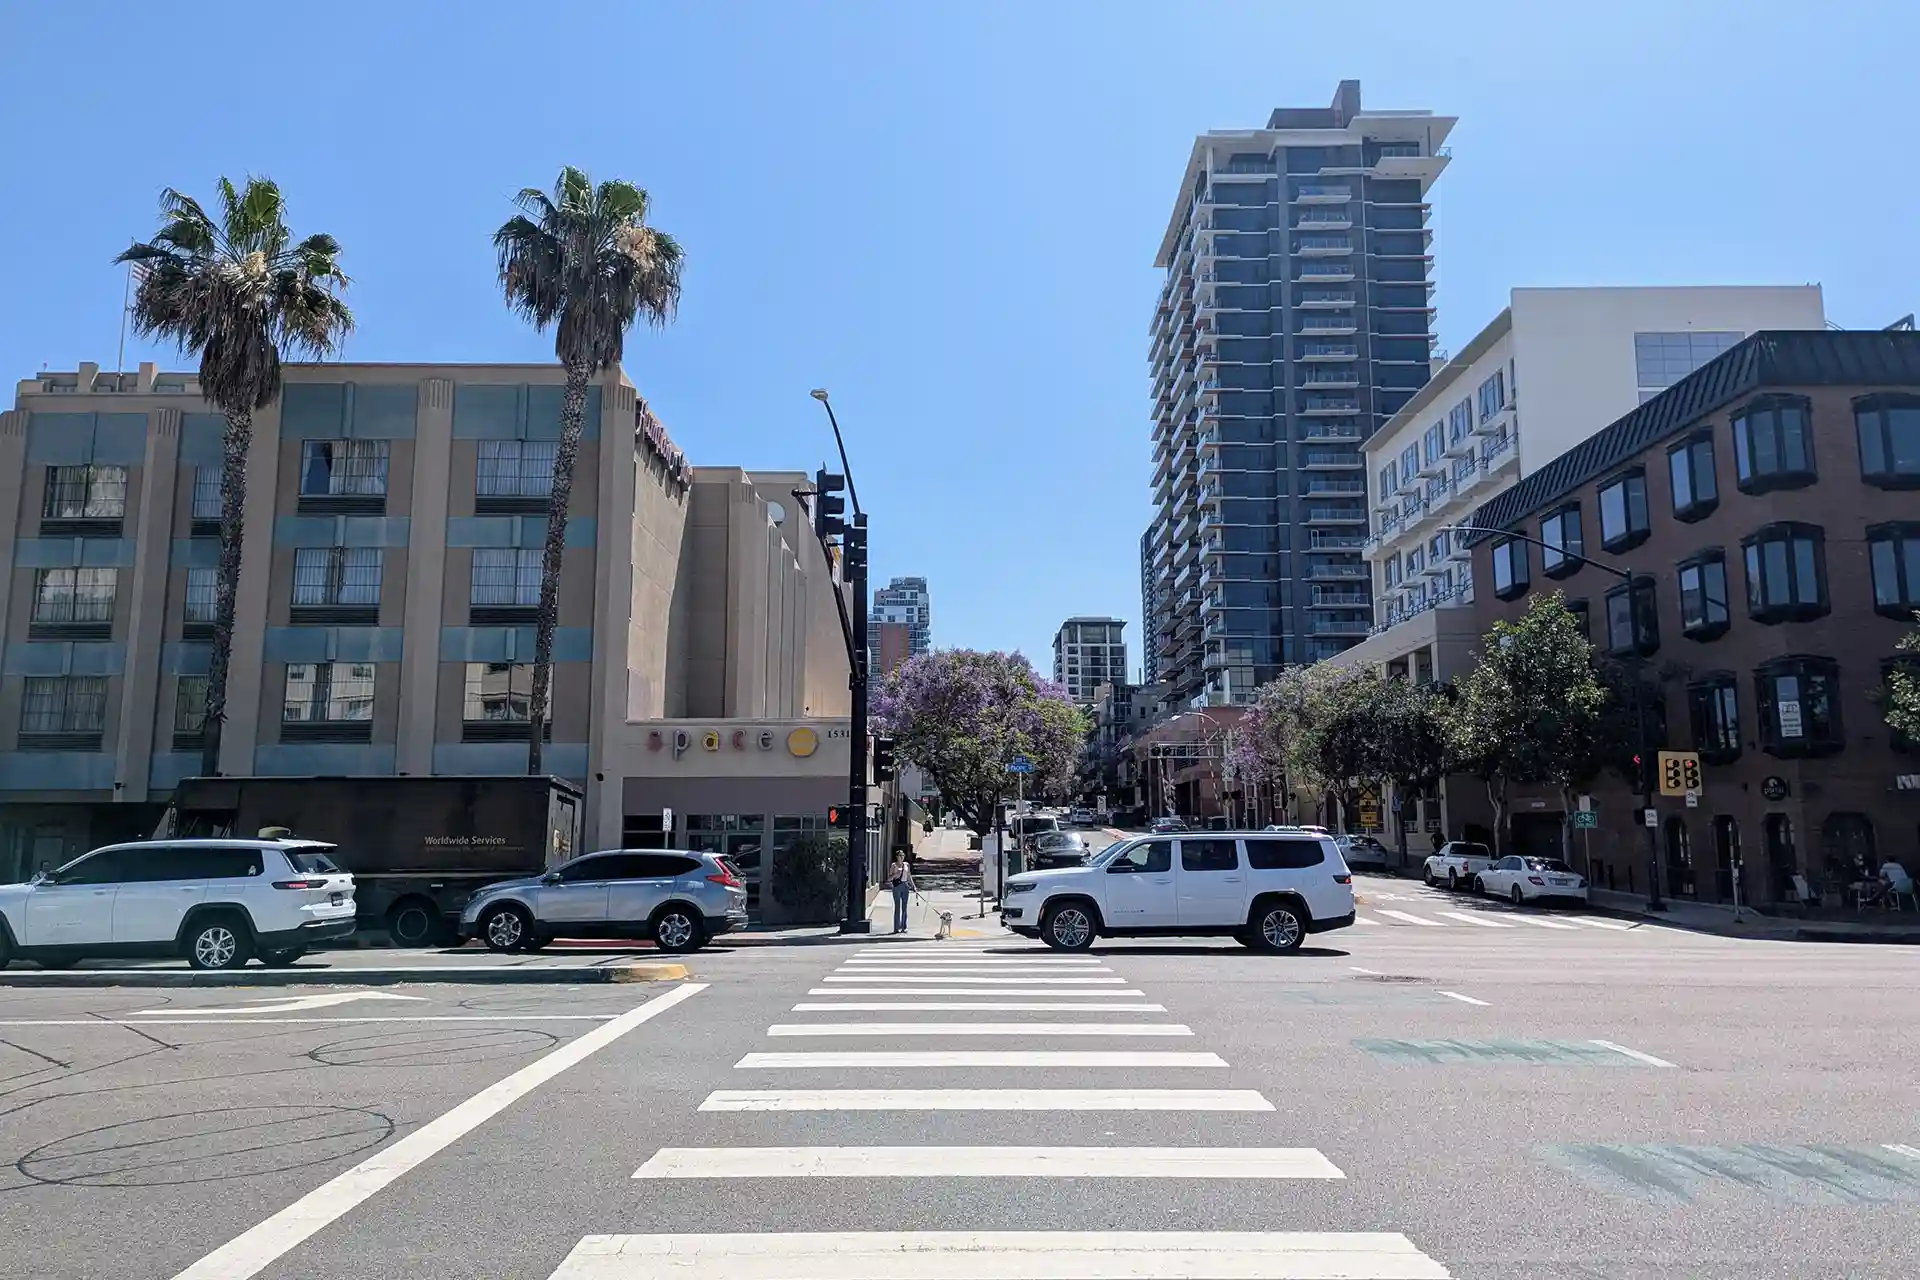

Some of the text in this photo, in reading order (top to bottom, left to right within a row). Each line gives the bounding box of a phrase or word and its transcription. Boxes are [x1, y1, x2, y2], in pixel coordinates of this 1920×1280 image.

[647, 729, 775, 761] space
[424, 835, 506, 845] Worldwide Services
